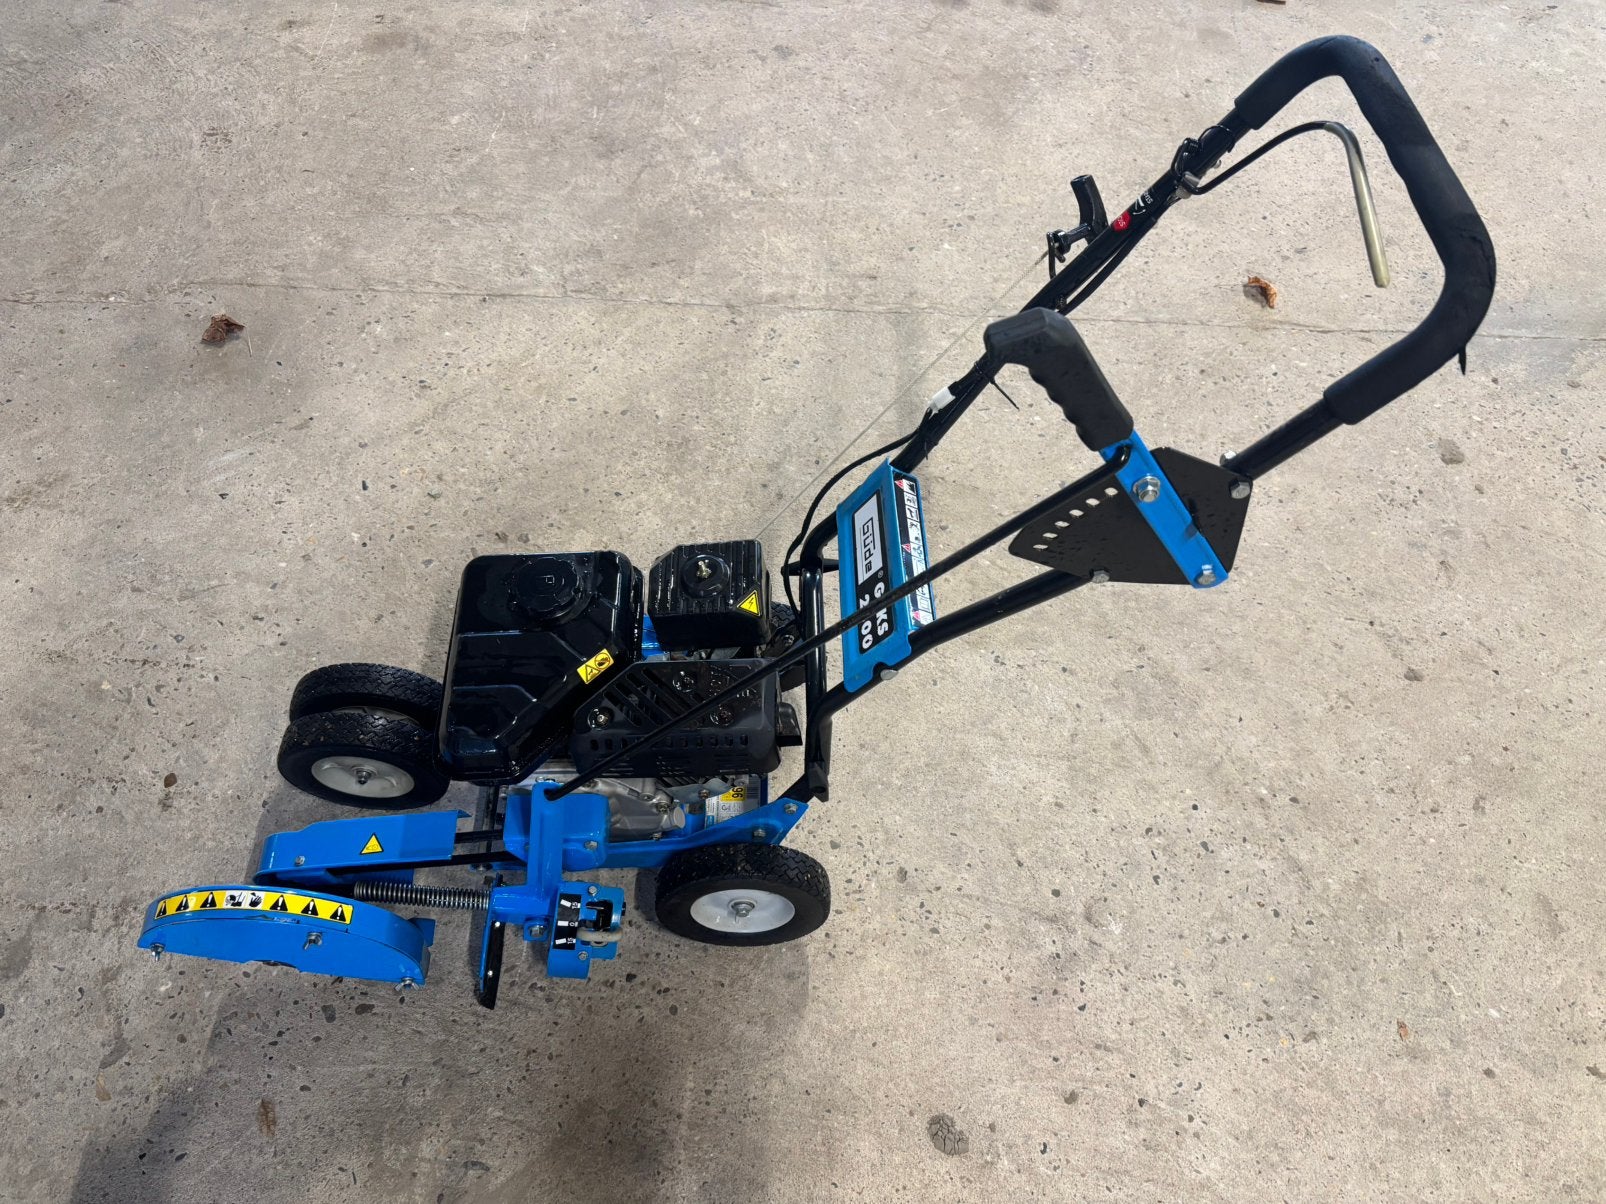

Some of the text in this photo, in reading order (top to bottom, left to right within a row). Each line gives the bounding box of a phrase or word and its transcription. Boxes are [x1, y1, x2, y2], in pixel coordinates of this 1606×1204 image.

[860, 594, 873, 649] 200
[874, 582, 888, 636] GKS
[732, 788, 743, 798] 96
